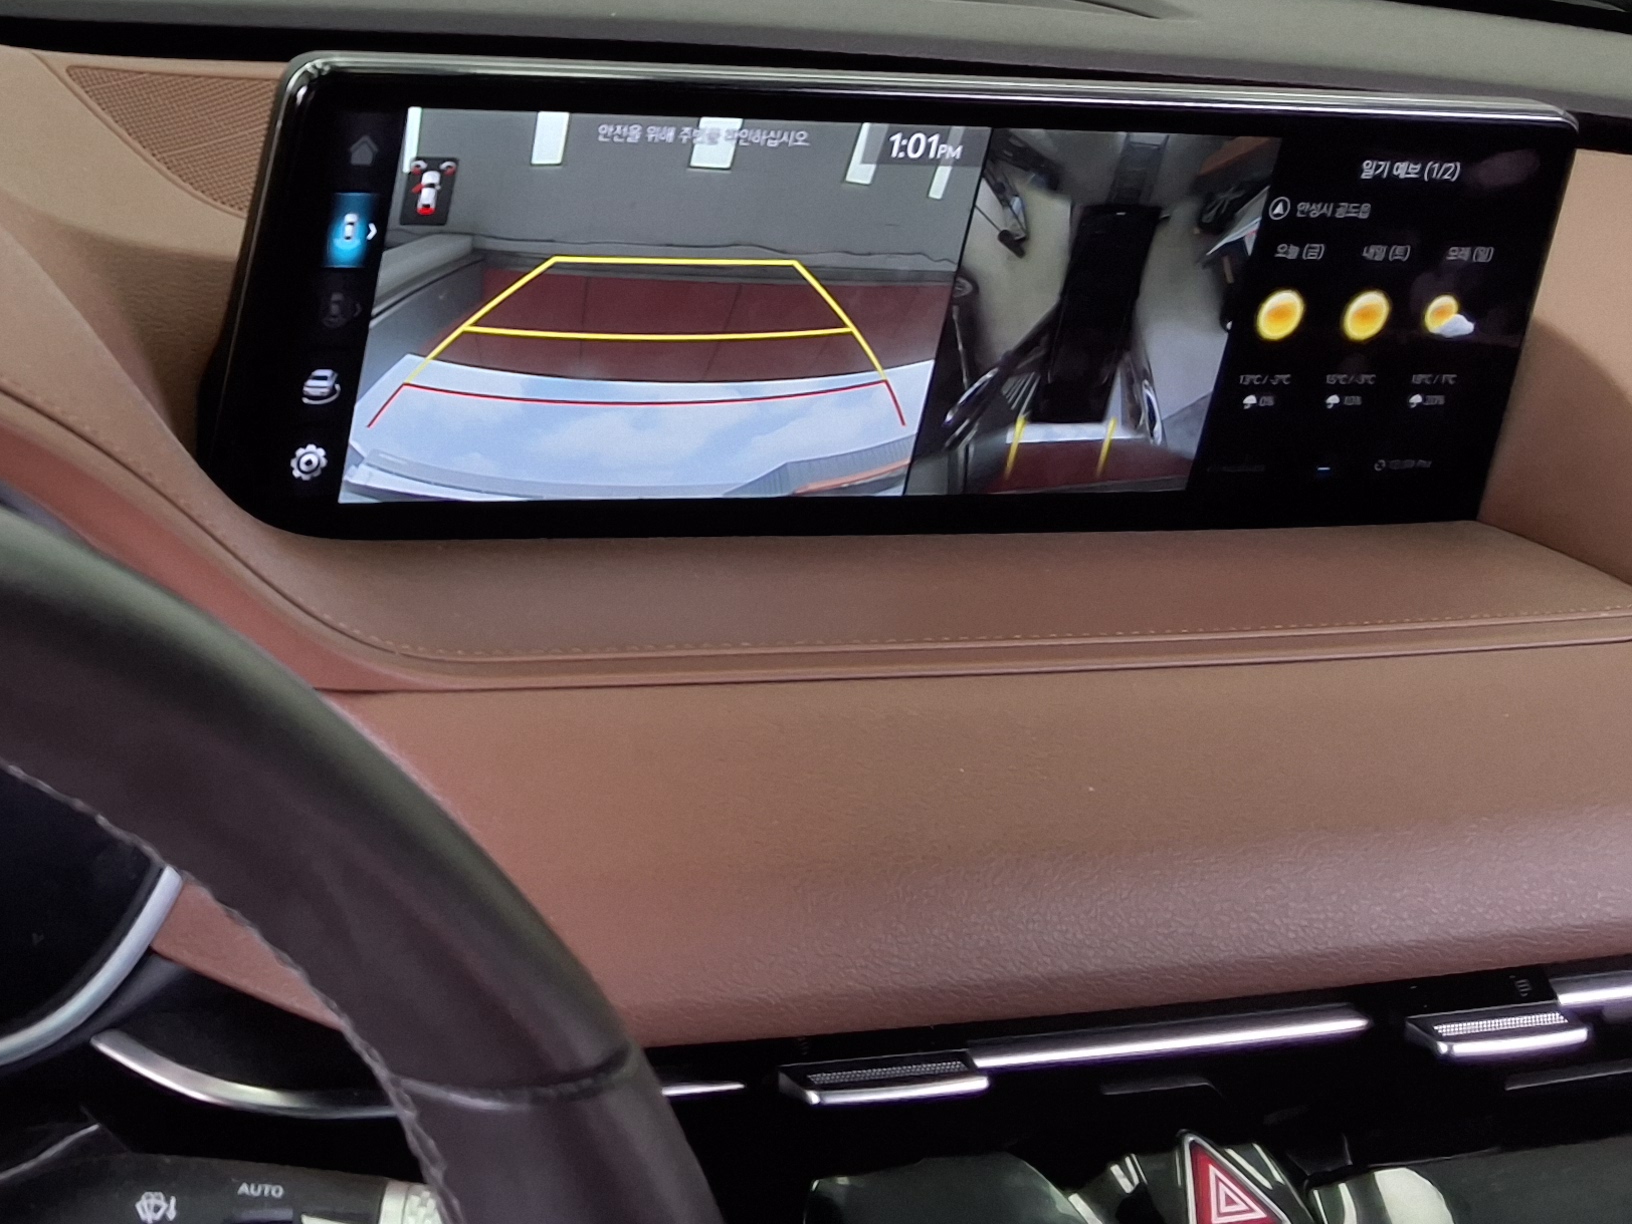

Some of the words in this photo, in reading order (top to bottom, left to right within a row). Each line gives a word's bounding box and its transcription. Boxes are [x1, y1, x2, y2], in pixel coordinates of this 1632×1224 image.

[597, 124, 643, 144] 안전을
[646, 126, 675, 144] 위해
[1360, 160, 1391, 179] 일기
[1392, 161, 1422, 179] 예보
[1424, 161, 1461, 182] (1/2)
[237, 1181, 284, 1198] AUTO
